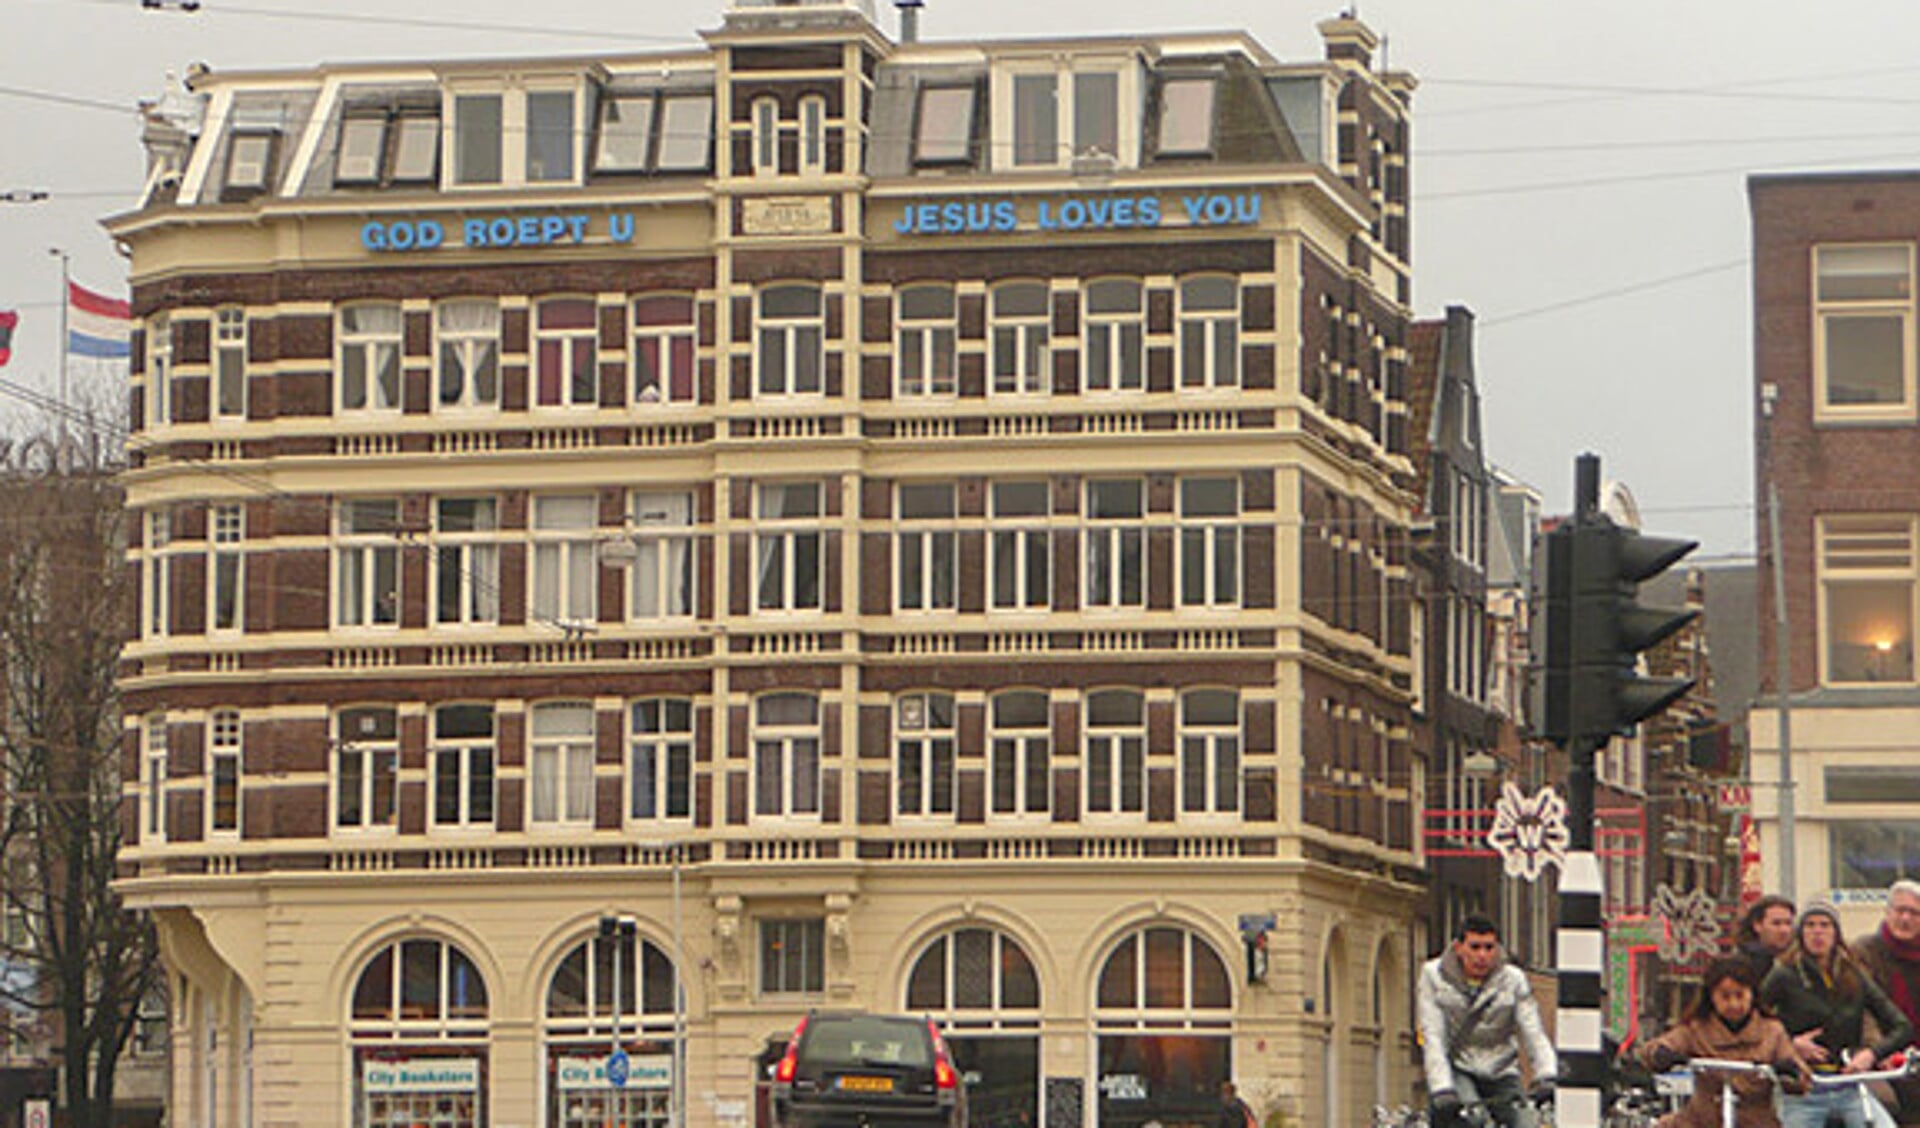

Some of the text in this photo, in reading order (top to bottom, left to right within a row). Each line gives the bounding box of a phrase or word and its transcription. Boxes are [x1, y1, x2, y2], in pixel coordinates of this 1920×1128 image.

[893, 195, 1262, 233] JESUS LOVES YOU
[360, 213, 636, 250] GOD ROEPT U
[367, 1070, 473, 1086] City Bookstore
[562, 1068, 589, 1081] City
